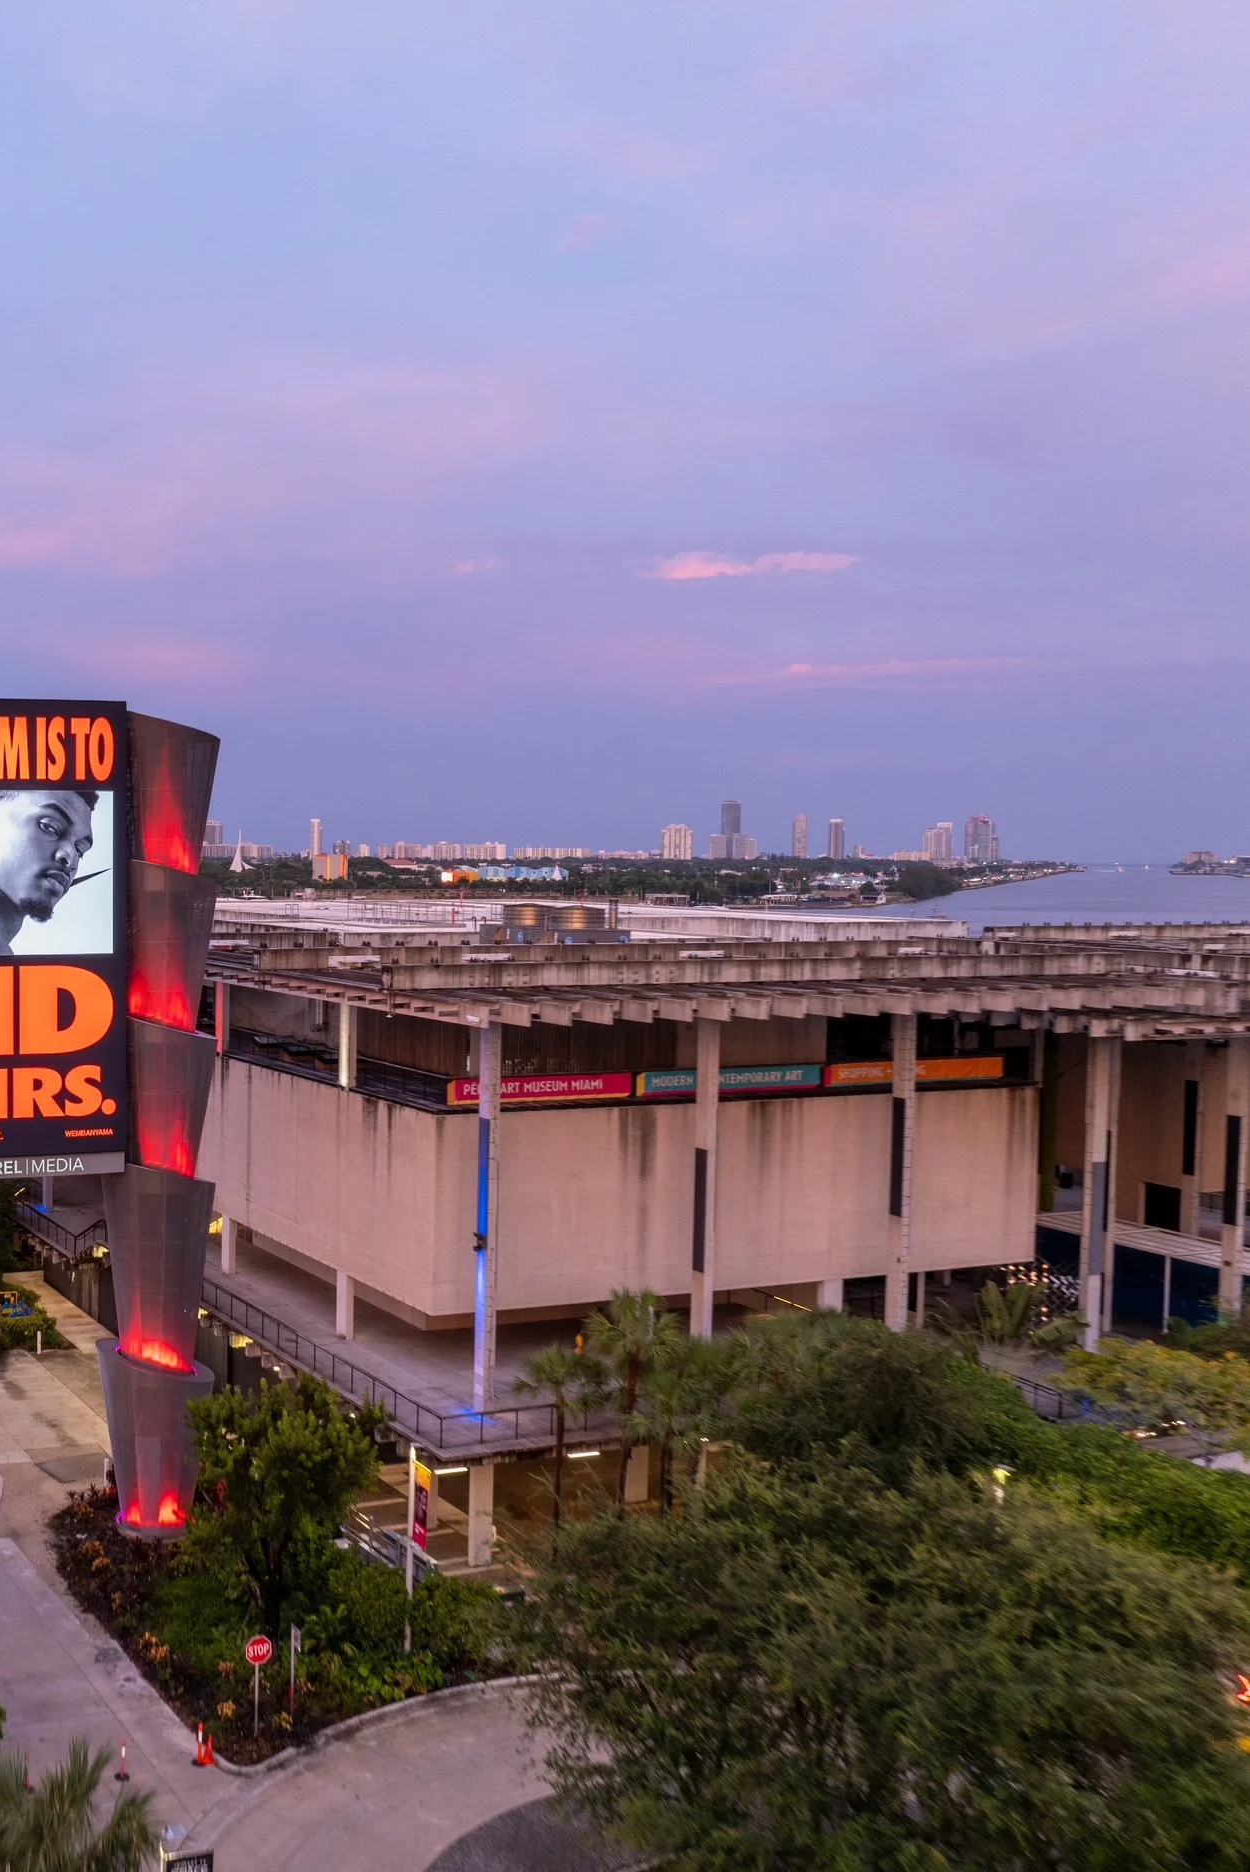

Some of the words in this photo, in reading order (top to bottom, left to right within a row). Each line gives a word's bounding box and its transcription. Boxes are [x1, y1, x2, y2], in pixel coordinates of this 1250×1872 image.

[36, 716, 66, 781] IS
[70, 716, 114, 781] TO
[652, 1075, 694, 1087] MODERN
[718, 1071, 781, 1085] NTEMPORARY
[784, 1070, 803, 1081] ART
[838, 1066, 884, 1079] SHOPPING
[501, 1082, 520, 1094] ART
[524, 1080, 568, 1093] MUSEUM
[571, 1079, 603, 1091] MIAMI
[64, 1128, 113, 1137] WEMBANYAMA
[31, 1157, 85, 1173] MEDIA
[248, 1643, 270, 1658] STOP
